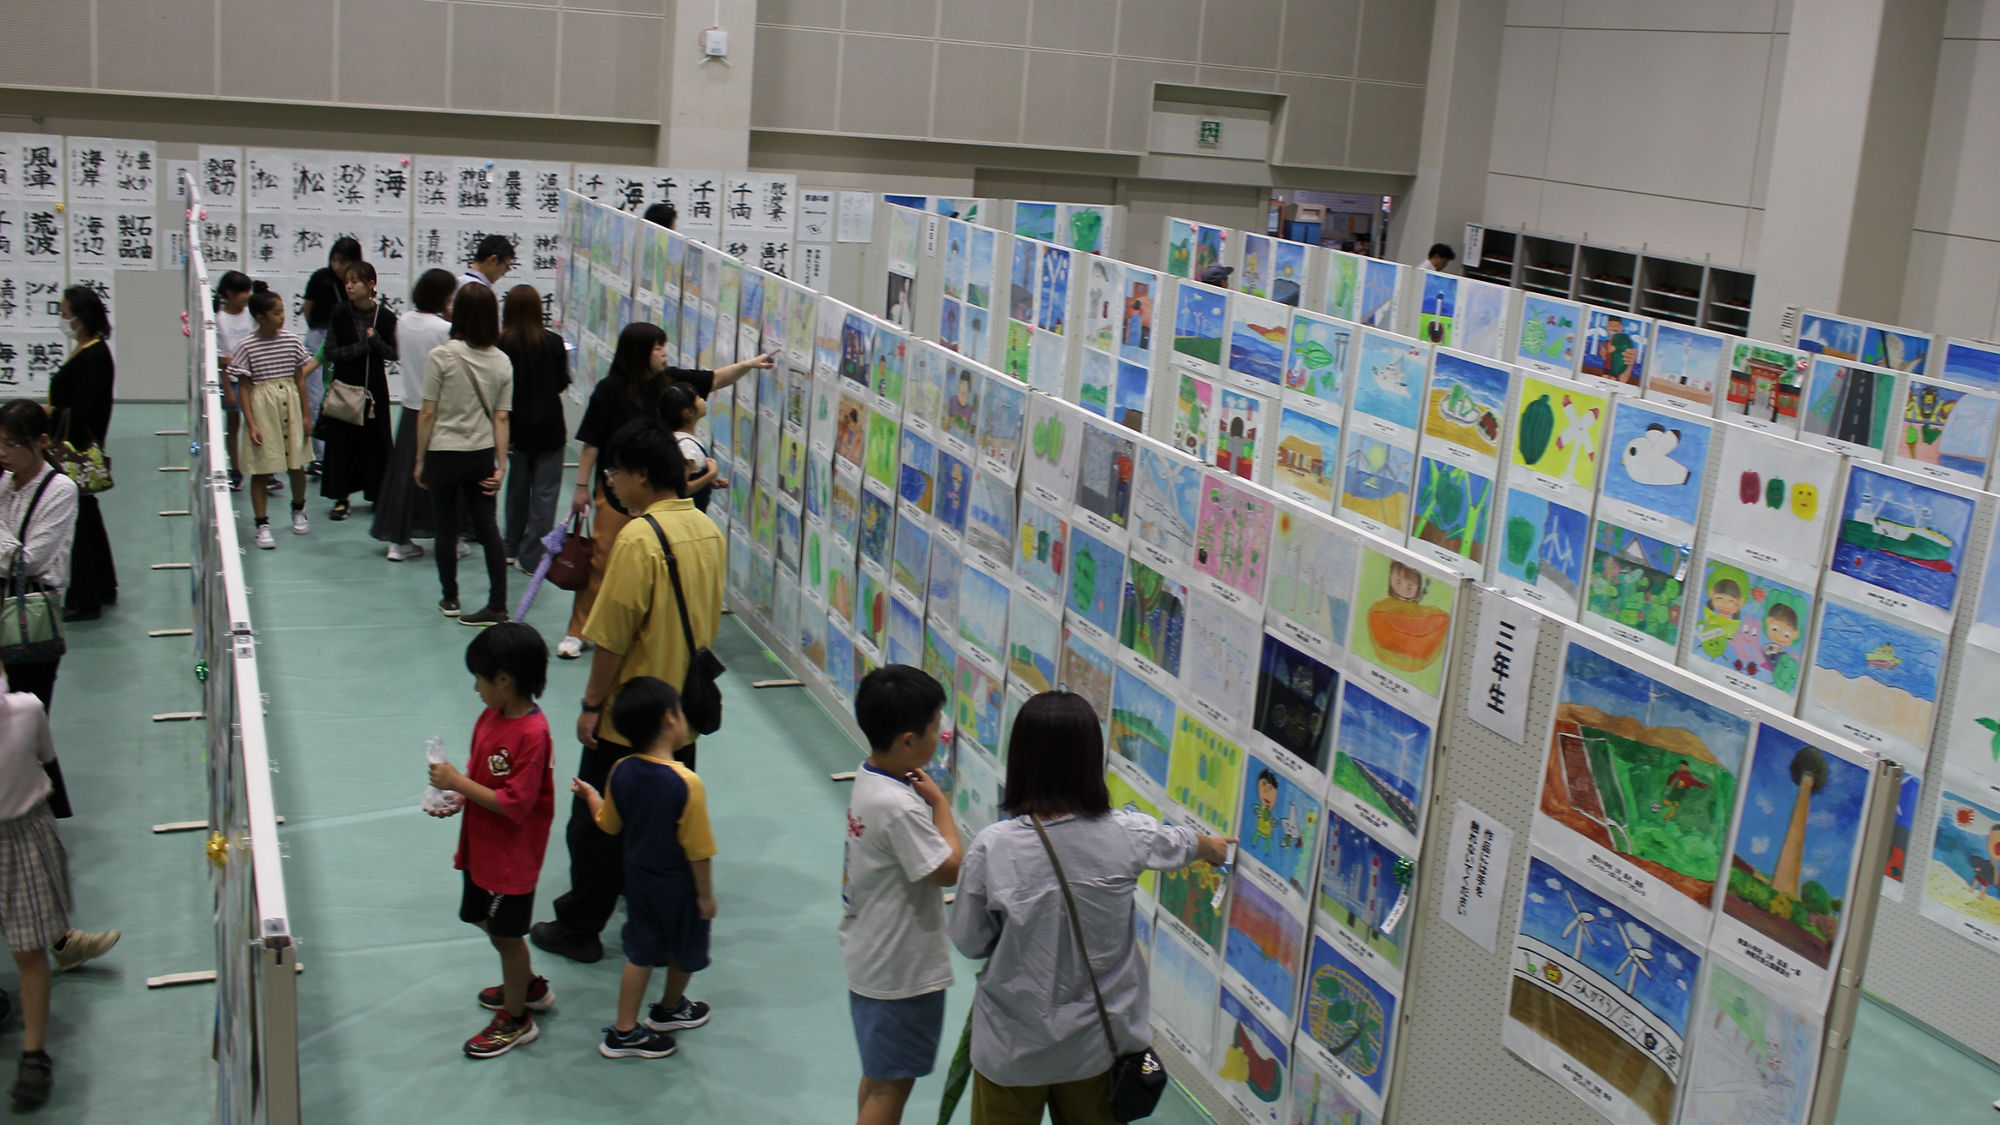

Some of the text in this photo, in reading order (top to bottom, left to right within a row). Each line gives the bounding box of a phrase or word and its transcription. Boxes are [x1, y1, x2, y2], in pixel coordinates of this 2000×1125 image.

[28, 146, 58, 190] 風車
[255, 168, 280, 192] 松
[300, 166, 325, 195] 松
[336, 163, 367, 204] 砂浜
[376, 168, 407, 198] 海
[586, 174, 603, 200] 千
[424, 170, 448, 205] 砂浜
[505, 170, 522, 210] 農業
[693, 180, 716, 219] 千両
[730, 182, 753, 220] 千両
[25, 211, 60, 255] 荒波
[258, 224, 279, 262] 風車
[298, 228, 324, 252] 松
[378, 235, 404, 259] 松
[1486, 620, 1516, 714] 三年生
